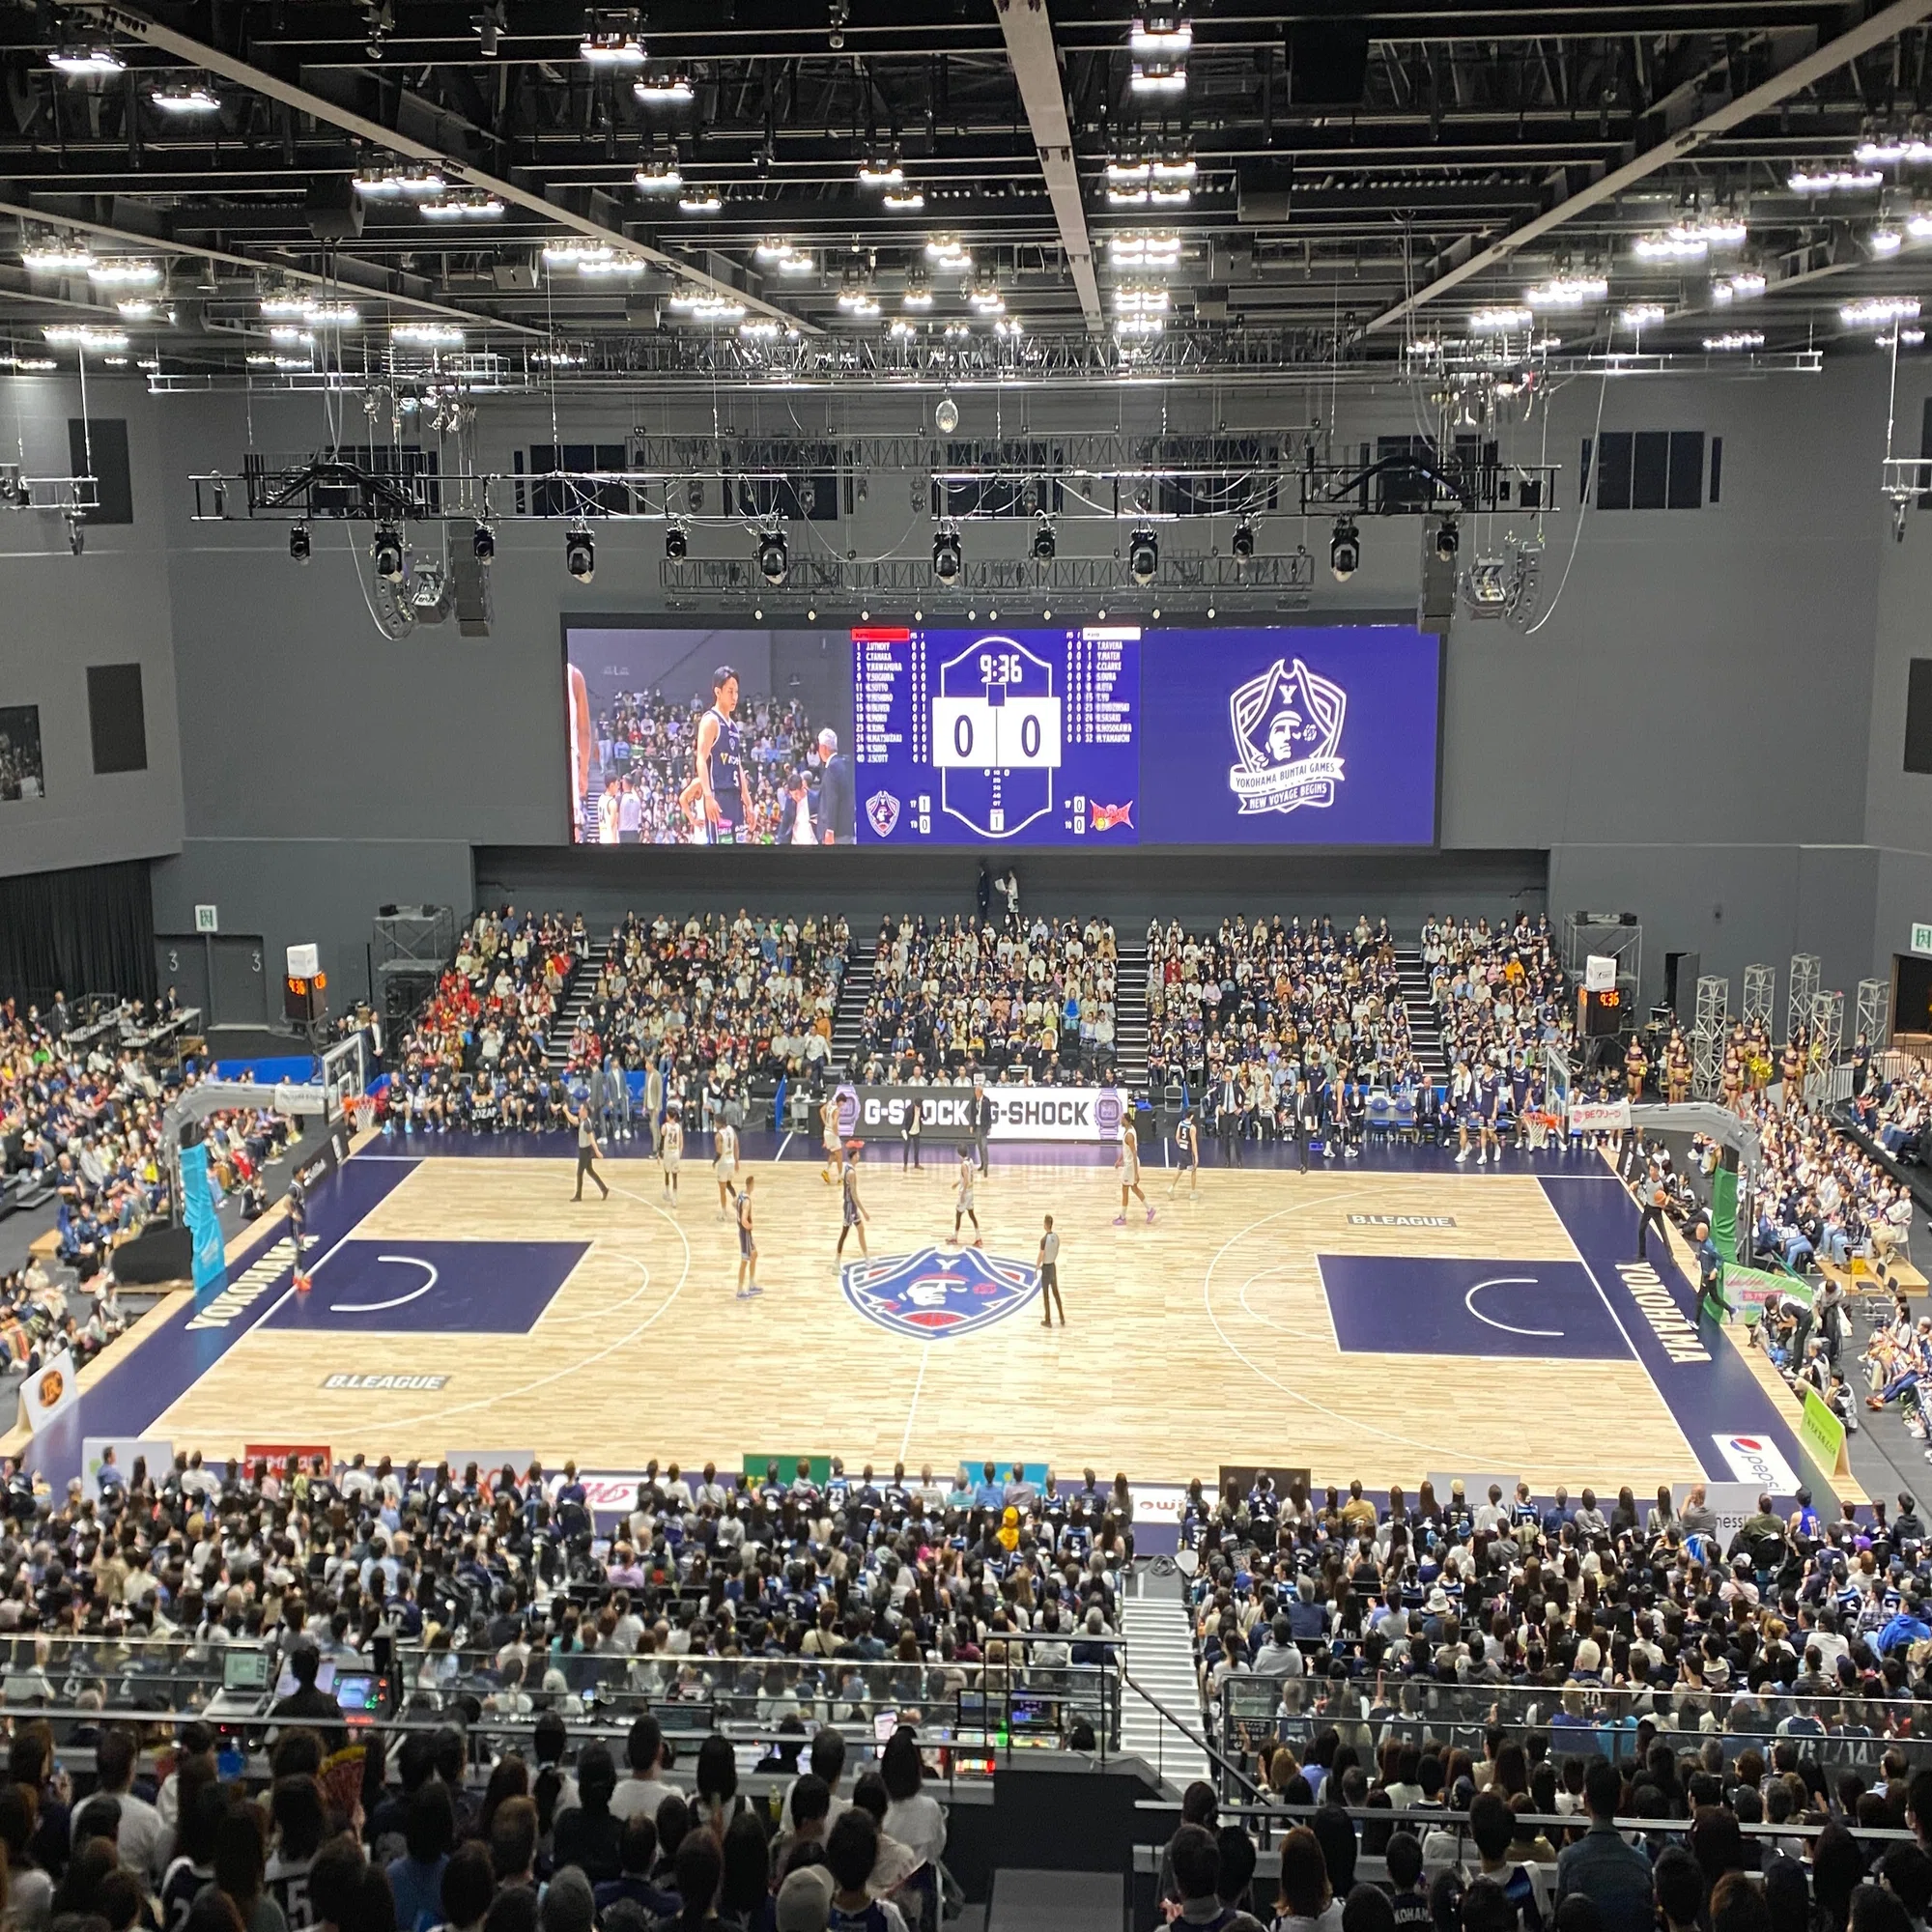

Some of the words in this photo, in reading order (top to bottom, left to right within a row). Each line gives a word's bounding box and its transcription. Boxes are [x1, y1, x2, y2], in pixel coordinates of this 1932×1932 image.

[980, 654, 1022, 682] 9:36
[1278, 684, 1297, 703] Y
[954, 715, 973, 757] 0
[1021, 715, 1040, 757] 0
[1236, 773, 1277, 788] YOKOHAMA
[1309, 761, 1335, 774] GAMES
[1077, 800, 1082, 811] 0
[1249, 794, 1267, 810] NEW
[1269, 788, 1298, 806] VOYAGE
[1300, 782, 1327, 798] BEGINS
[923, 819, 927, 831] 0
[1077, 820, 1082, 831] 0
[1600, 992, 1619, 1007] 9:36
[865, 1098, 970, 1125] G-SOCK
[990, 1101, 1090, 1126] G-SHOCK
[1181, 1127, 1187, 1139] 5
[1351, 1215, 1452, 1227] B.LEAGUE
[935, 1259, 960, 1270] Y
[1614, 1261, 1713, 1363] YOKOHAMA
[325, 1375, 446, 1389] B.LEAGUE
[1741, 1455, 1787, 1492] pepsi
[829, 1487, 846, 1507] 23
[1846, 1741, 1868, 1765] 14
